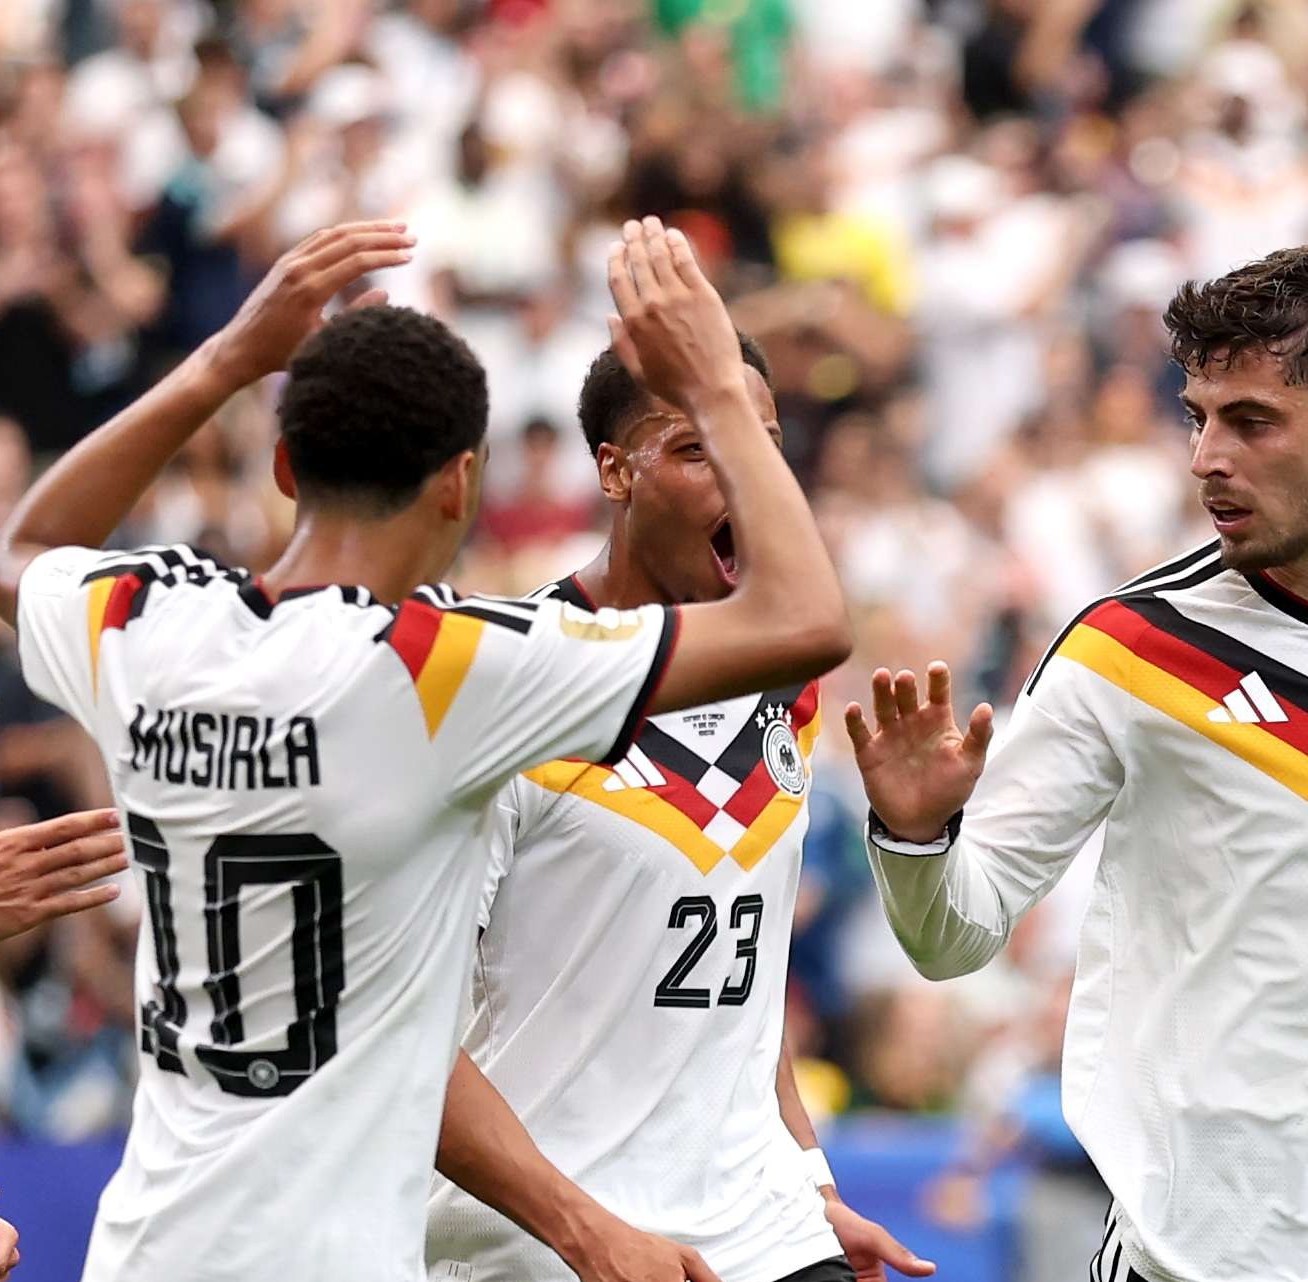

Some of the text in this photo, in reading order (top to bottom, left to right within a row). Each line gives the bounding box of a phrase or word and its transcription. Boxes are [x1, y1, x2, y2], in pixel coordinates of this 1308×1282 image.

[129, 704, 320, 790] MUSIALA
[127, 811, 345, 1098] 10
[653, 893, 765, 1009] 23
